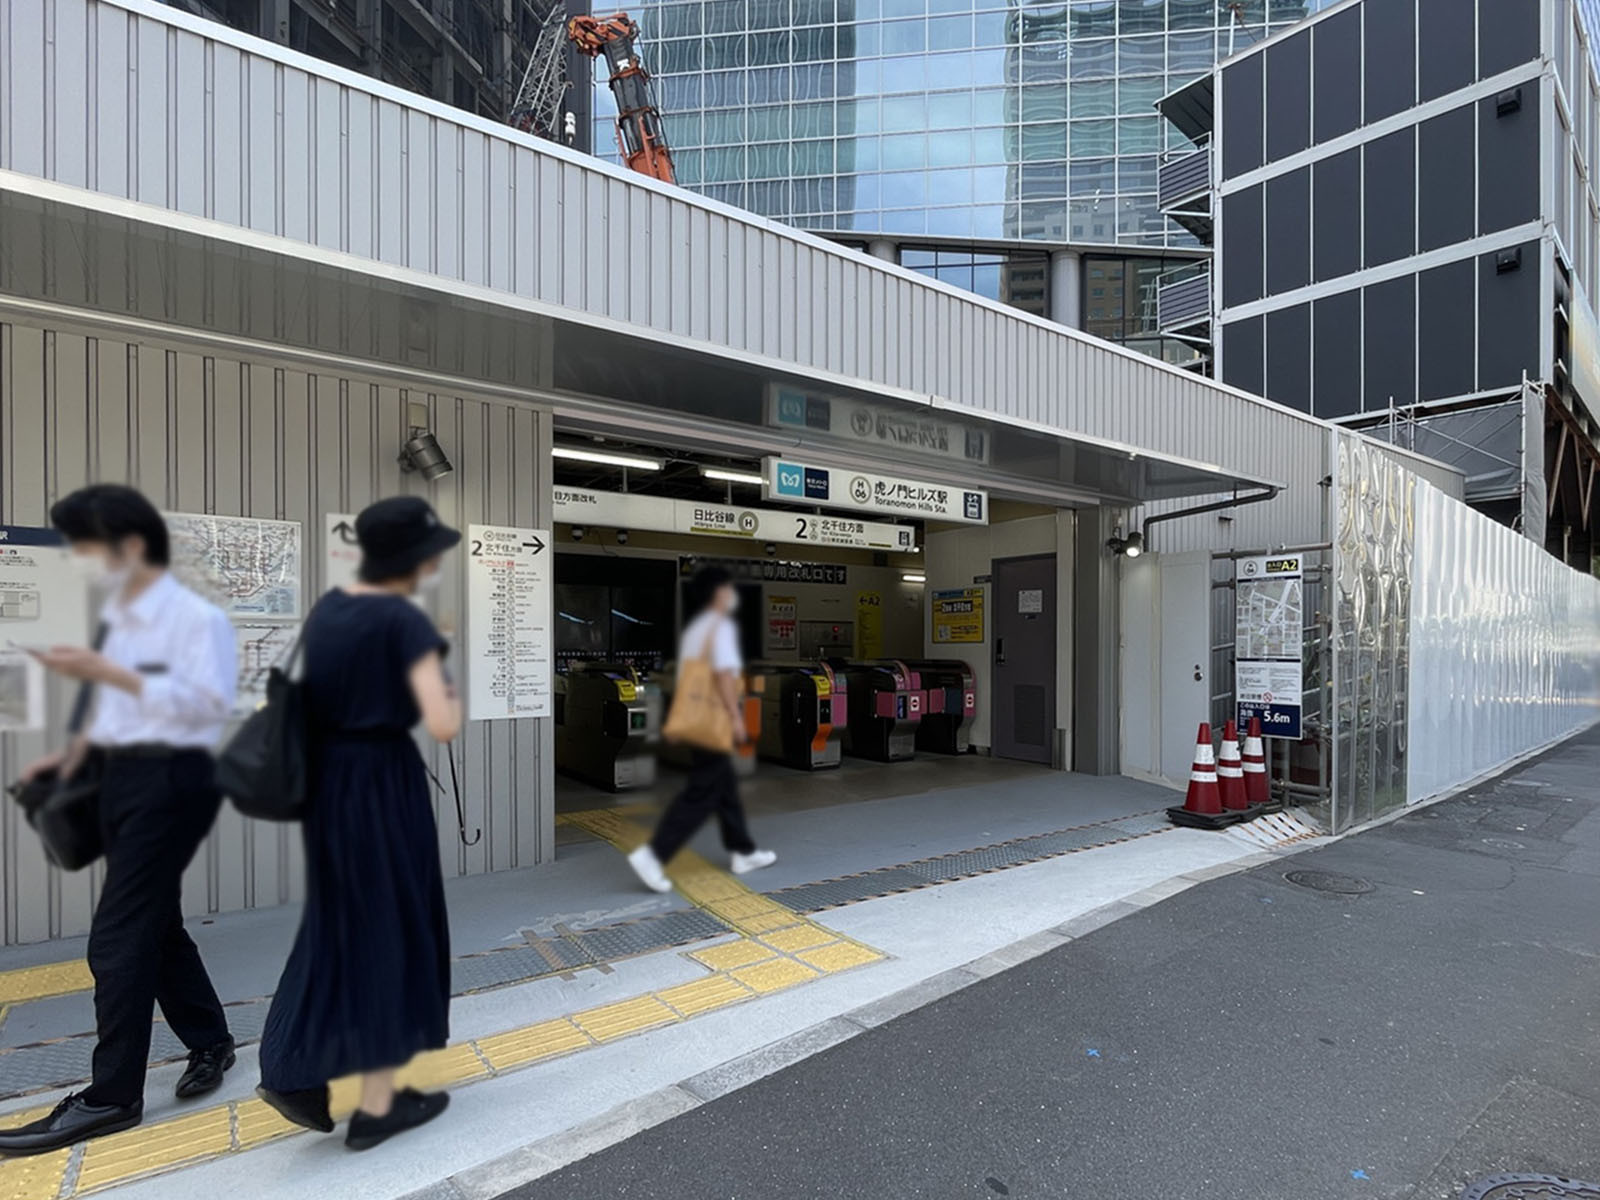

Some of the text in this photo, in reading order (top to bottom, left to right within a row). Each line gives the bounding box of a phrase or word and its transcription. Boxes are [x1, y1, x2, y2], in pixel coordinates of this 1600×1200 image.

[855, 489, 867, 499] 06
[874, 481, 948, 504] 虎ノ門ヒルズ駅
[874, 496, 917, 510] Toranomon
[918, 501, 933, 512] Hills
[694, 509, 735, 524] 日比谷線
[745, 518, 753, 528] H
[795, 518, 864, 539] 2 北千住方面
[471, 540, 483, 556] 2
[1281, 560, 1297, 571] A2
[1263, 710, 1291, 724] 5.6m
